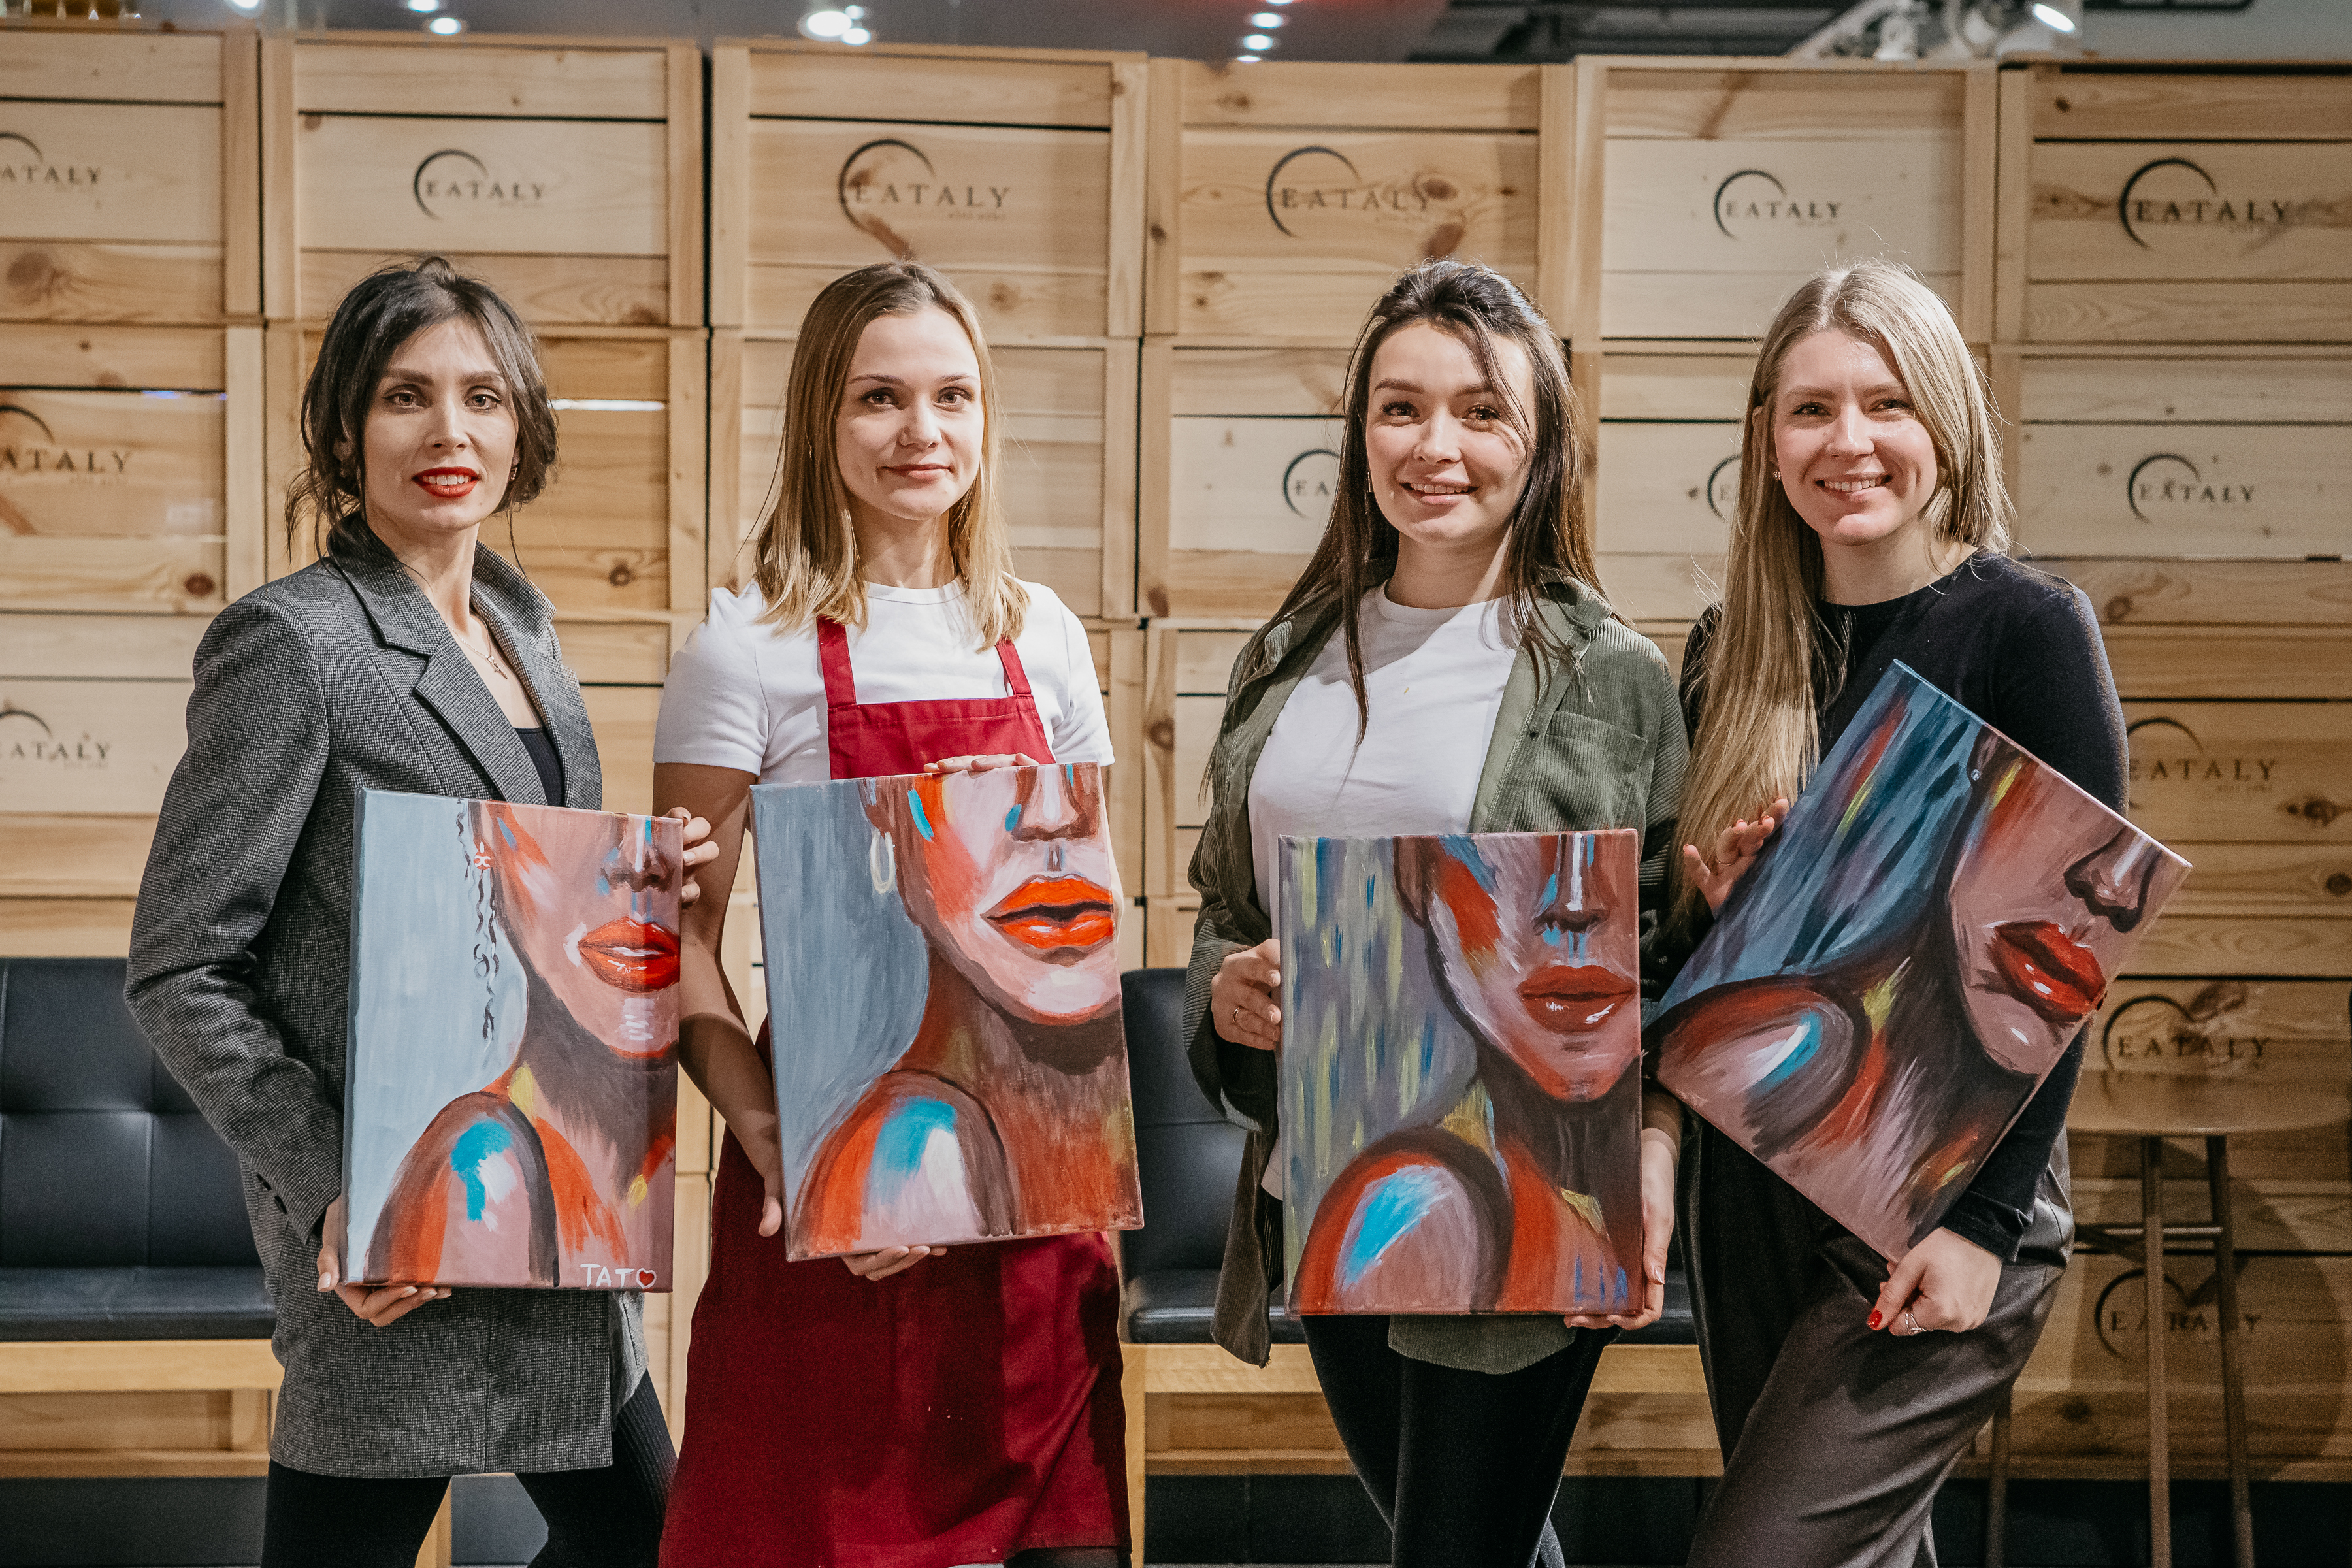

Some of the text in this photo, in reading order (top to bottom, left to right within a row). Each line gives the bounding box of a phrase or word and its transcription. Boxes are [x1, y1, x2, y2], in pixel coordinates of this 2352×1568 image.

[425, 180, 546, 200] EATALY
[852, 182, 1011, 208] EATALY
[1281, 187, 1433, 211] EATALY
[1725, 200, 1842, 220] EATALY
[2134, 199, 2291, 223] EATALY
[2139, 483, 2255, 503] EATALY
[0, 740, 112, 760] ATALY
[2118, 1035, 2270, 1058] EATALY
